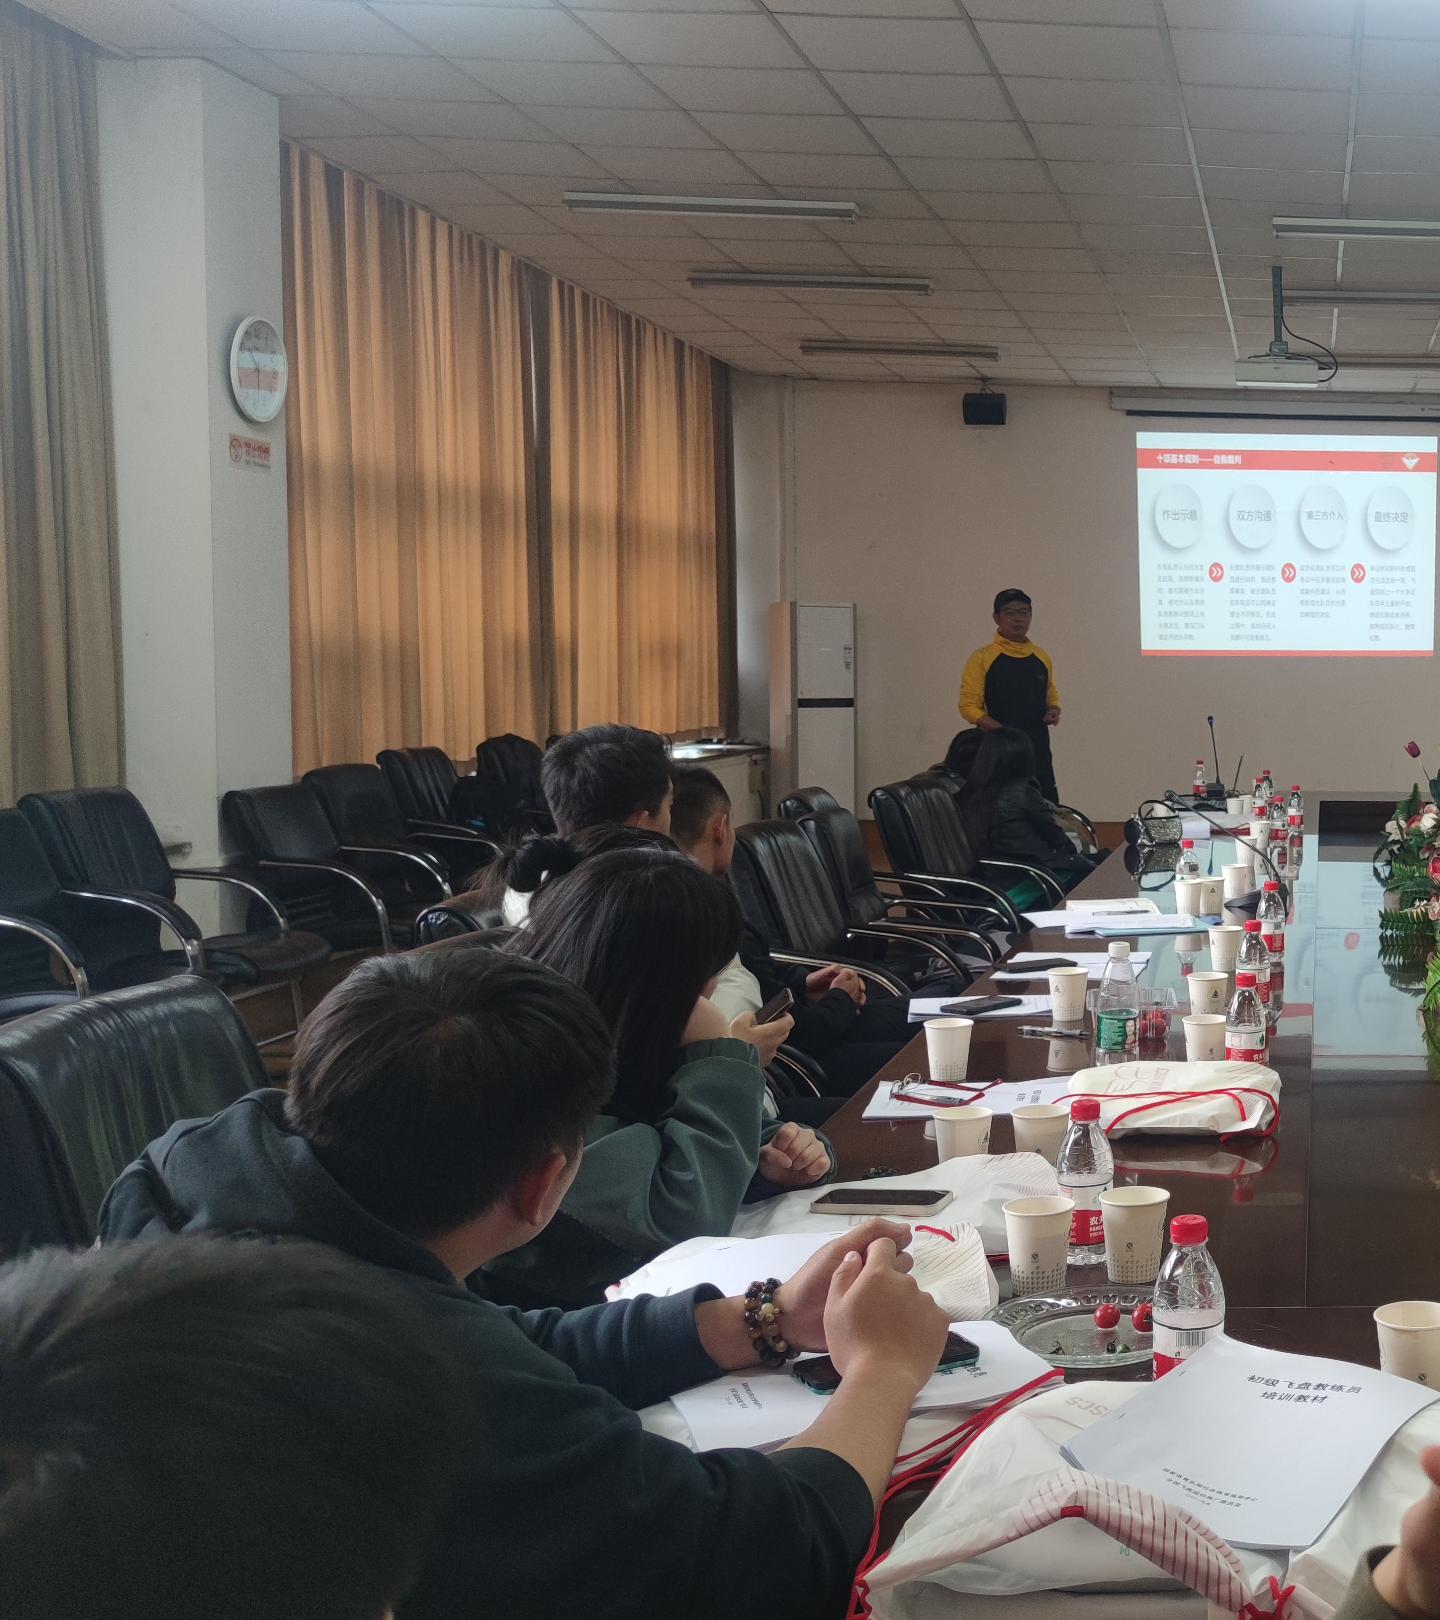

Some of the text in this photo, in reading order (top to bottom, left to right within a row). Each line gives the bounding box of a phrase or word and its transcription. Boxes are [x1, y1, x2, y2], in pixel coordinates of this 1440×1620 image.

[1237, 510, 1272, 522] 双方沟通
[1305, 510, 1344, 521] 第三方介入
[1374, 511, 1409, 523] 最终决定
[1247, 1374, 1362, 1394] 初级飞盘教练员
[1260, 1391, 1328, 1403] 培训教材
